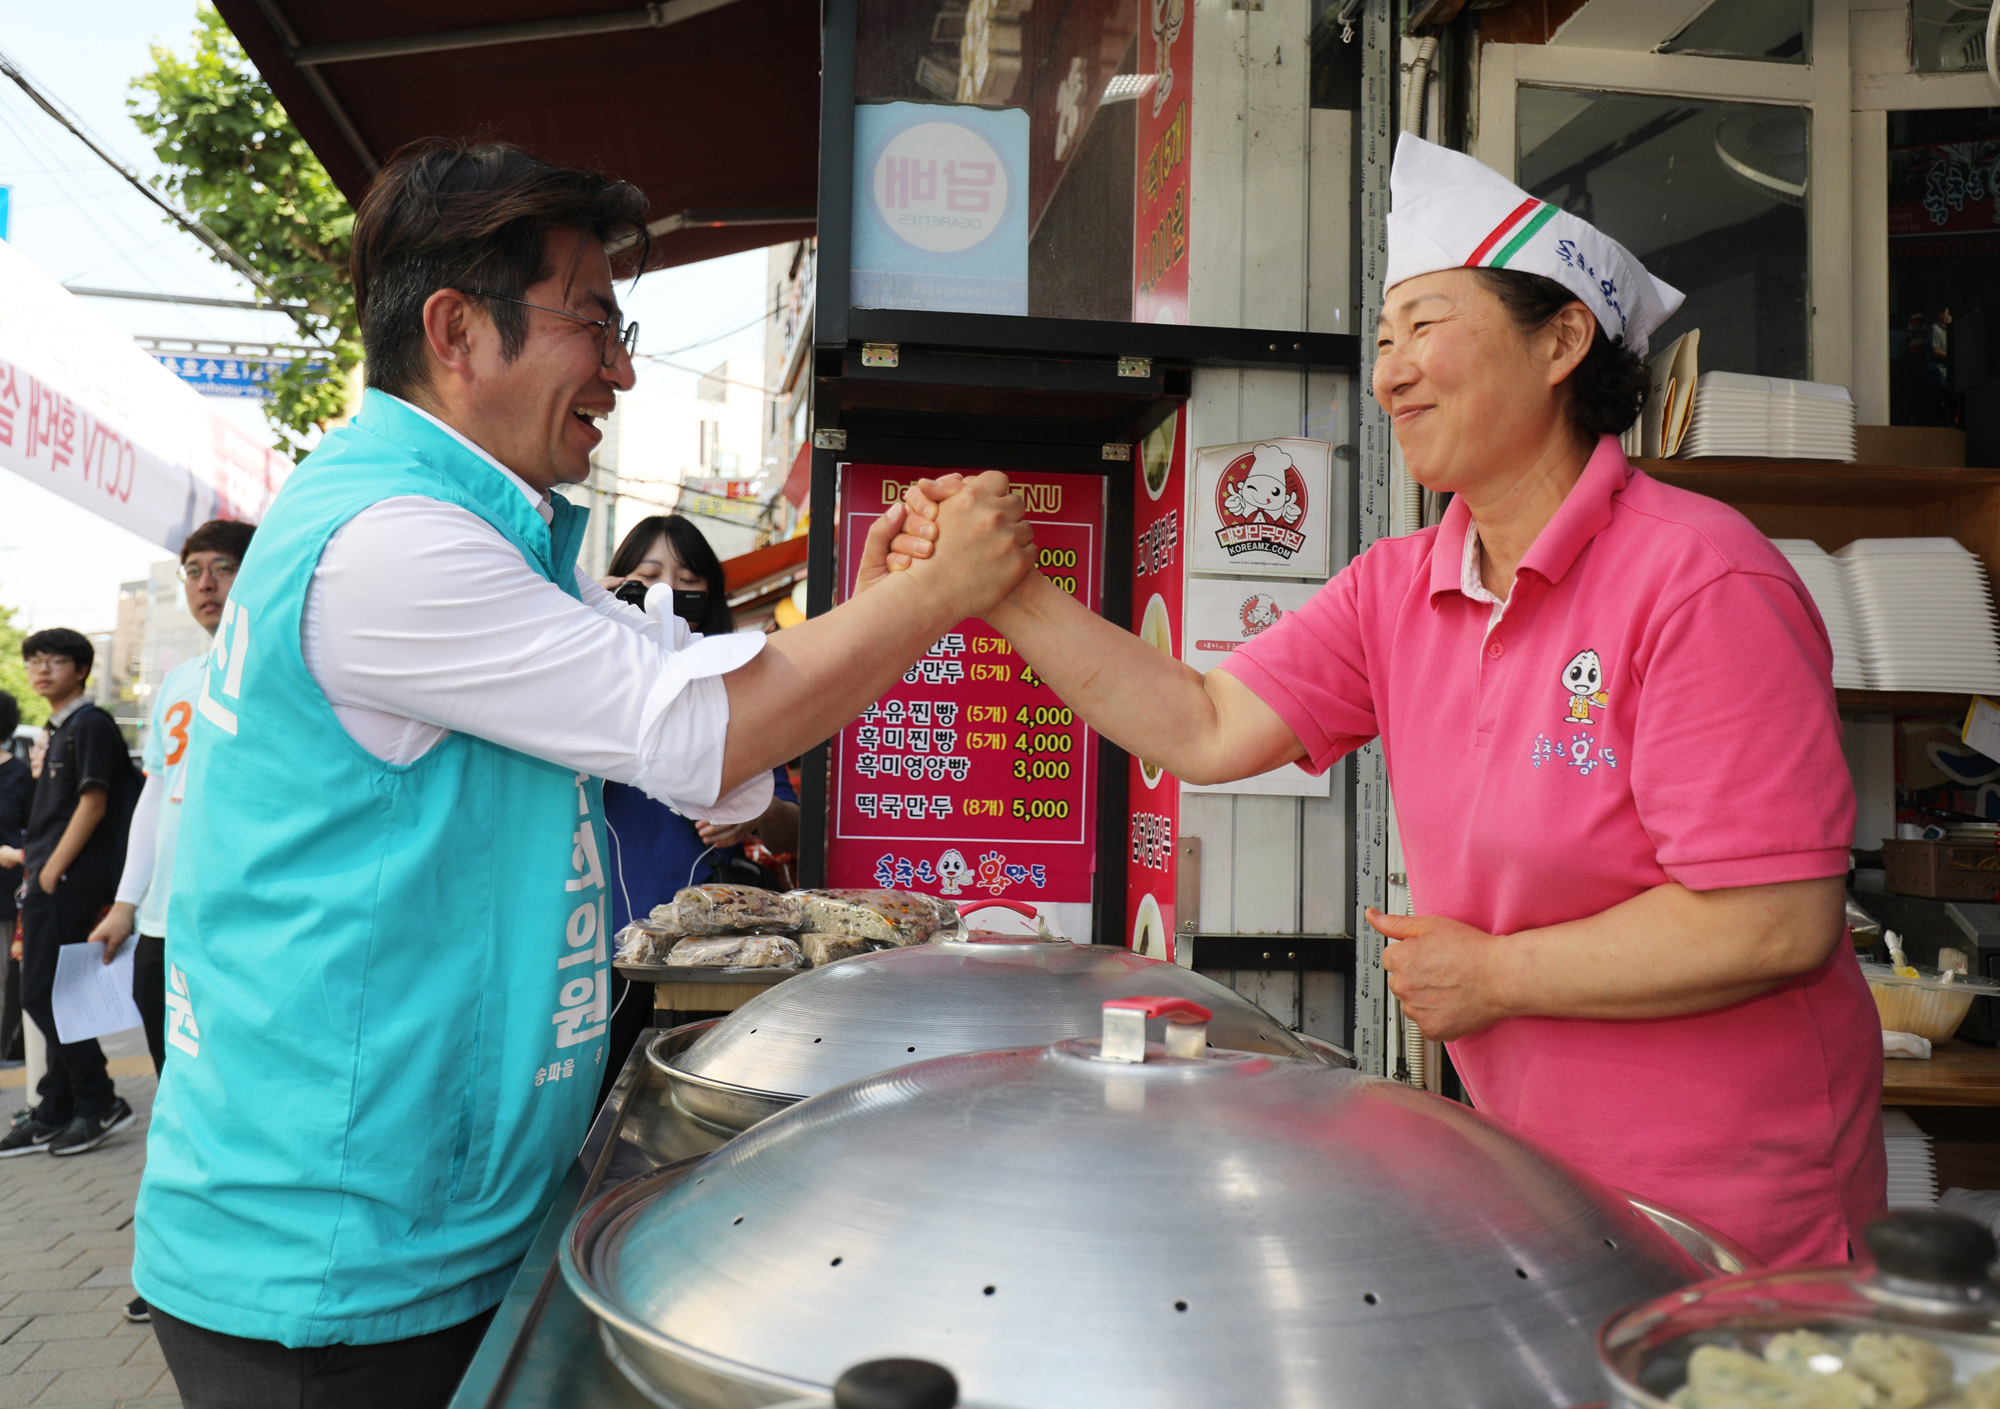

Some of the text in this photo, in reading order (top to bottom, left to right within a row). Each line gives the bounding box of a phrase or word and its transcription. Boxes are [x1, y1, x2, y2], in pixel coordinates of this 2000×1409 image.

[1137, 508, 1178, 577] 고기왕만두
[1217, 524, 1304, 552] 대한민국맛집
[1229, 542, 1292, 558] KOREAMZ.COM
[972, 637, 1012, 655] (5개)
[970, 664, 1011, 682] (5개)
[967, 705, 1008, 723] (5개)
[1015, 706, 1073, 729] 4,000
[164, 701, 192, 766] 3
[857, 725, 1072, 756] 흑미찐빵 (5개) 4,000
[856, 753, 1071, 782] 흑미영양빵 3,000
[856, 793, 1069, 822] 떡국만두 (8개) 5,000
[1132, 811, 1171, 873] 김치왕만두
[534, 1058, 575, 1087] 송파을
